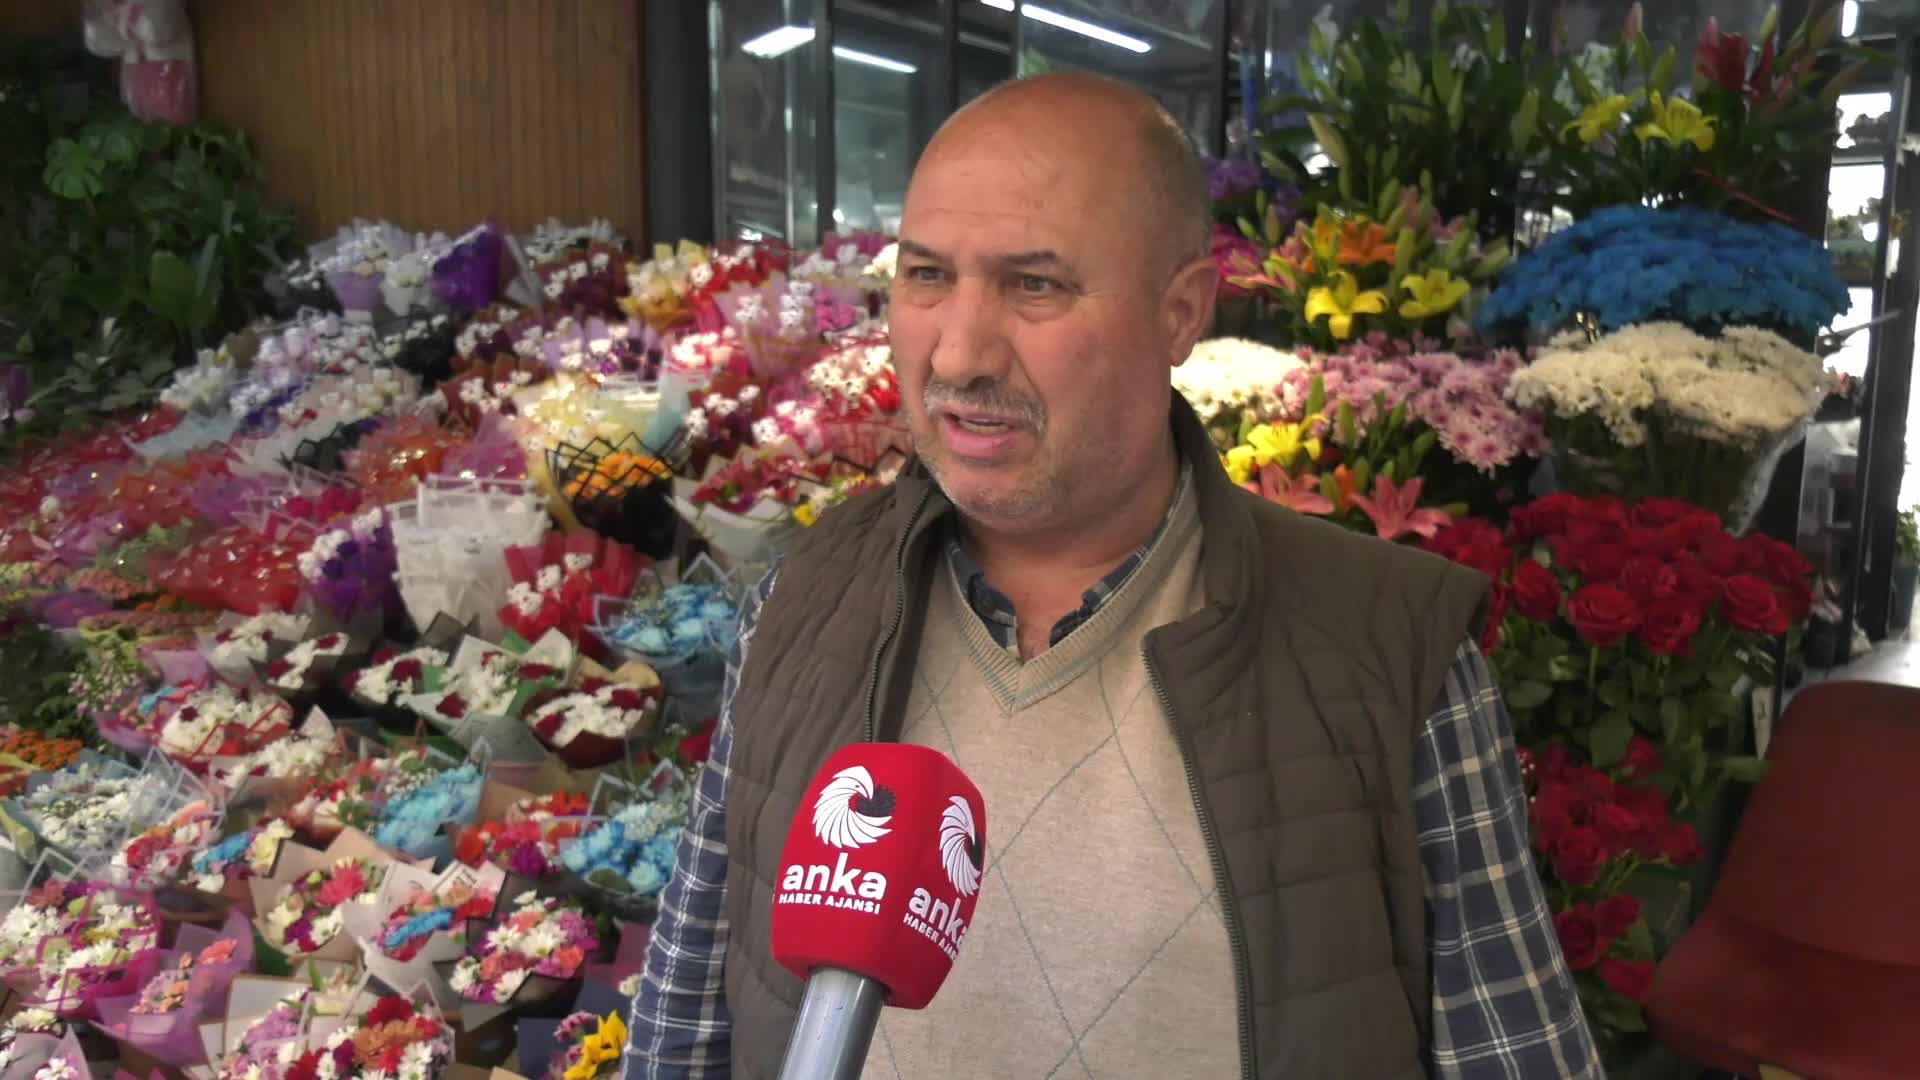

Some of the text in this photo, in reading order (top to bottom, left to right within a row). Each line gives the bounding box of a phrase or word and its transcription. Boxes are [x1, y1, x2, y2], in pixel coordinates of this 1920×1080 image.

[782, 852, 887, 900] anka
[779, 893, 881, 915] HABER AJANSI
[903, 912, 940, 943] HABER
